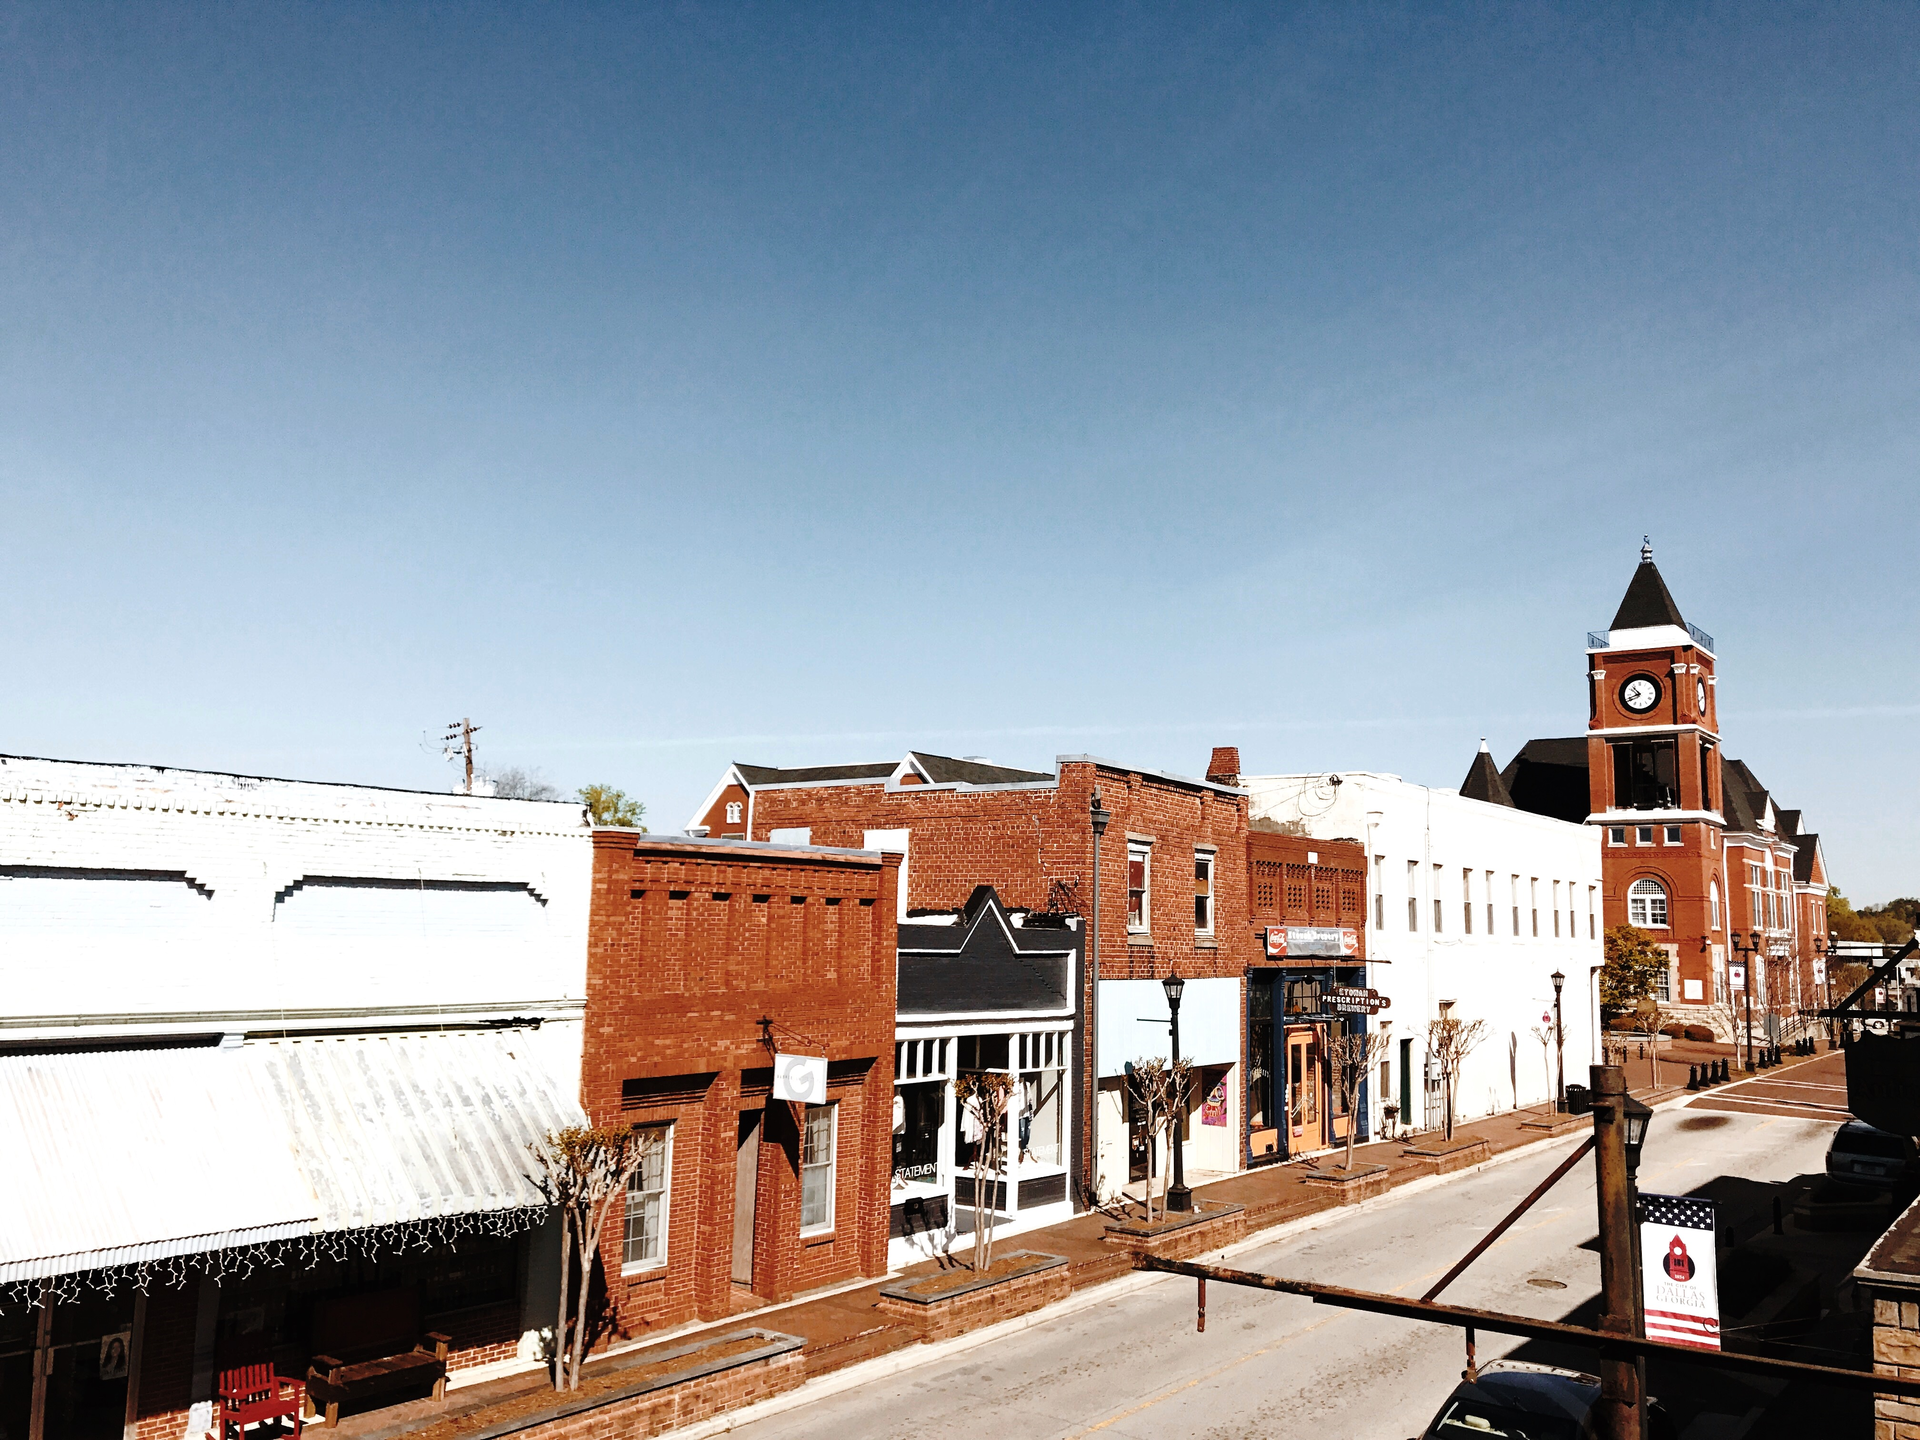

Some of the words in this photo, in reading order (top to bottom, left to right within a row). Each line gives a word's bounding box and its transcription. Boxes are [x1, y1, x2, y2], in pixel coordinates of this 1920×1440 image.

[1338, 988, 1369, 997] ETOWAH
[1322, 995, 1387, 1007] PRESCRIPTION'S
[1336, 1003, 1371, 1014] BREWERY
[1656, 1285, 1705, 1300] DALLAS
[1656, 1294, 1706, 1309] GEORGIA
